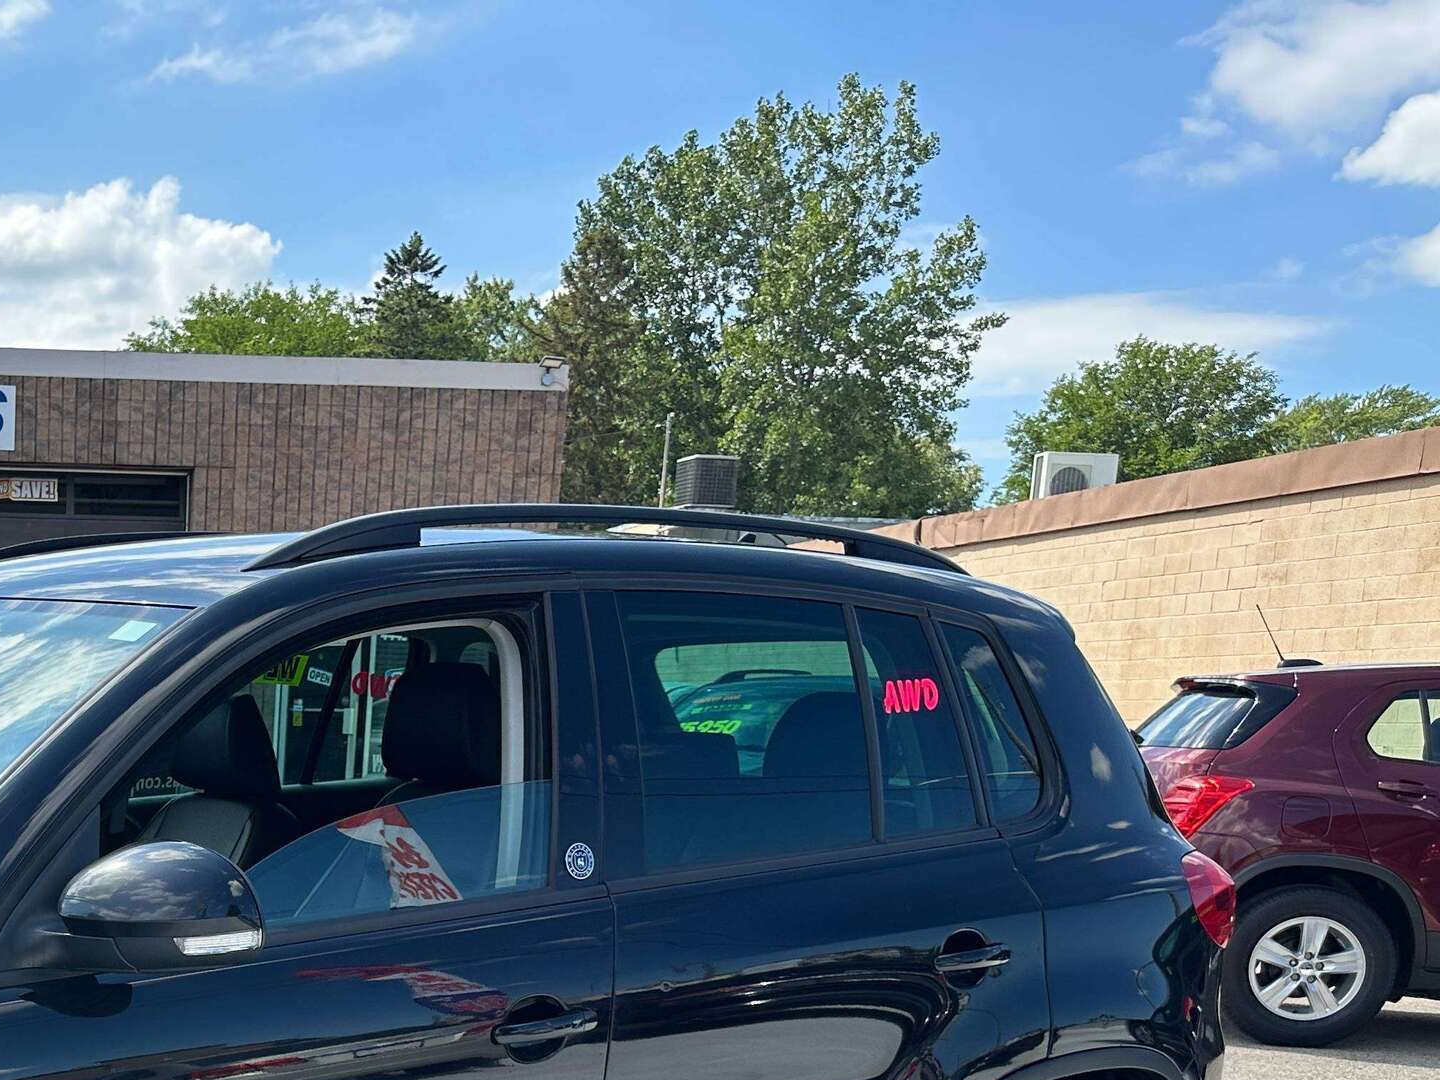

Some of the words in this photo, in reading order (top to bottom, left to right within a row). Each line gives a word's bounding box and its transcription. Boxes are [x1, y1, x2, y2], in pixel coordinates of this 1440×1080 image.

[11, 480, 55, 498] SAVE!
[309, 669, 330, 684] OPEN
[883, 678, 939, 714] AWD
